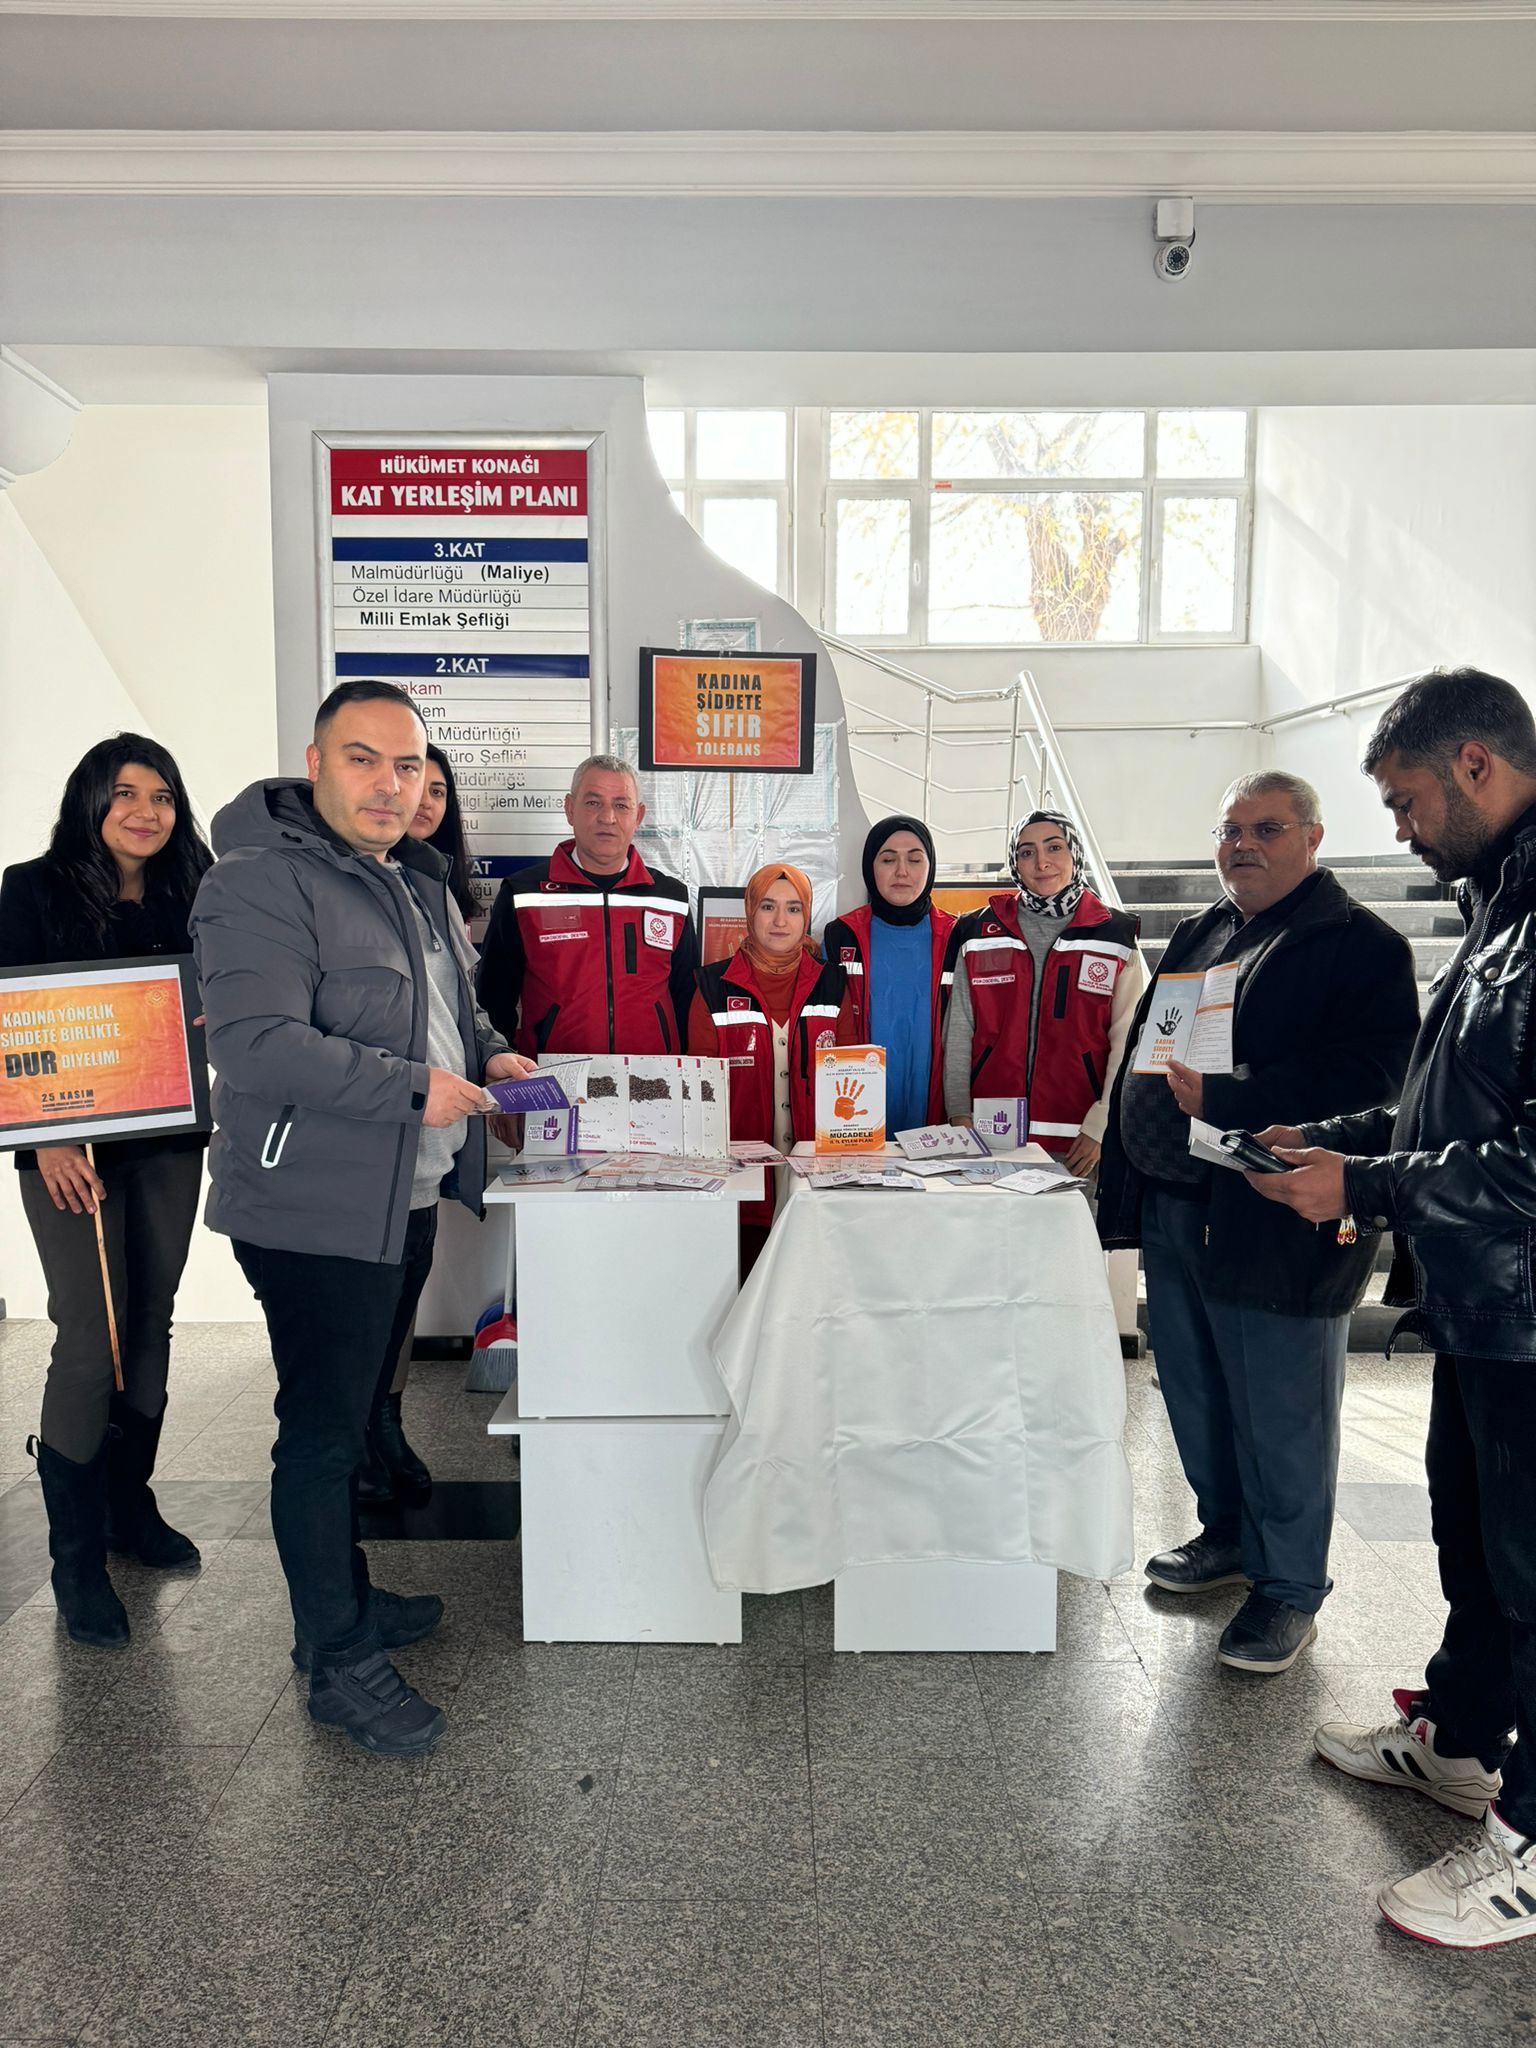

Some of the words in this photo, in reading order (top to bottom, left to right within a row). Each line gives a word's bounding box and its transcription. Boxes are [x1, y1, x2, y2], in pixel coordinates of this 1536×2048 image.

[380, 455, 466, 474] HÜKÜMET
[472, 454, 540, 474] KONAĞI
[341, 485, 384, 507] KAT
[390, 480, 502, 513] YERLEŞİM
[510, 485, 578, 507] PLANI
[434, 542, 485, 558] 3.KAT
[351, 565, 463, 583] Malmüdürlüğü
[480, 565, 550, 584] (Maliye)
[353, 586, 388, 603] Özel
[394, 586, 433, 603] İdare
[439, 588, 522, 607] Müdürlüğü
[360, 611, 394, 626] Milli
[400, 612, 451, 627] Emlak
[457, 611, 510, 630] Şefliği
[436, 658, 489, 673] 2.KAT
[697, 673, 762, 691] KADINA
[697, 690, 762, 713] ŞİDDETE
[696, 712, 761, 738] SIFIR
[439, 726, 521, 745] Müdürlüğü
[480, 748, 527, 767] Şefliği
[696, 741, 761, 757] TOLERANS
[2, 1009, 56, 1028] KADINA
[4, 1050, 58, 1079] DUR
[41, 1093, 55, 1103] 25
[59, 1089, 94, 1100] KASIM
[830, 1131, 873, 1139] MÜCADELE
